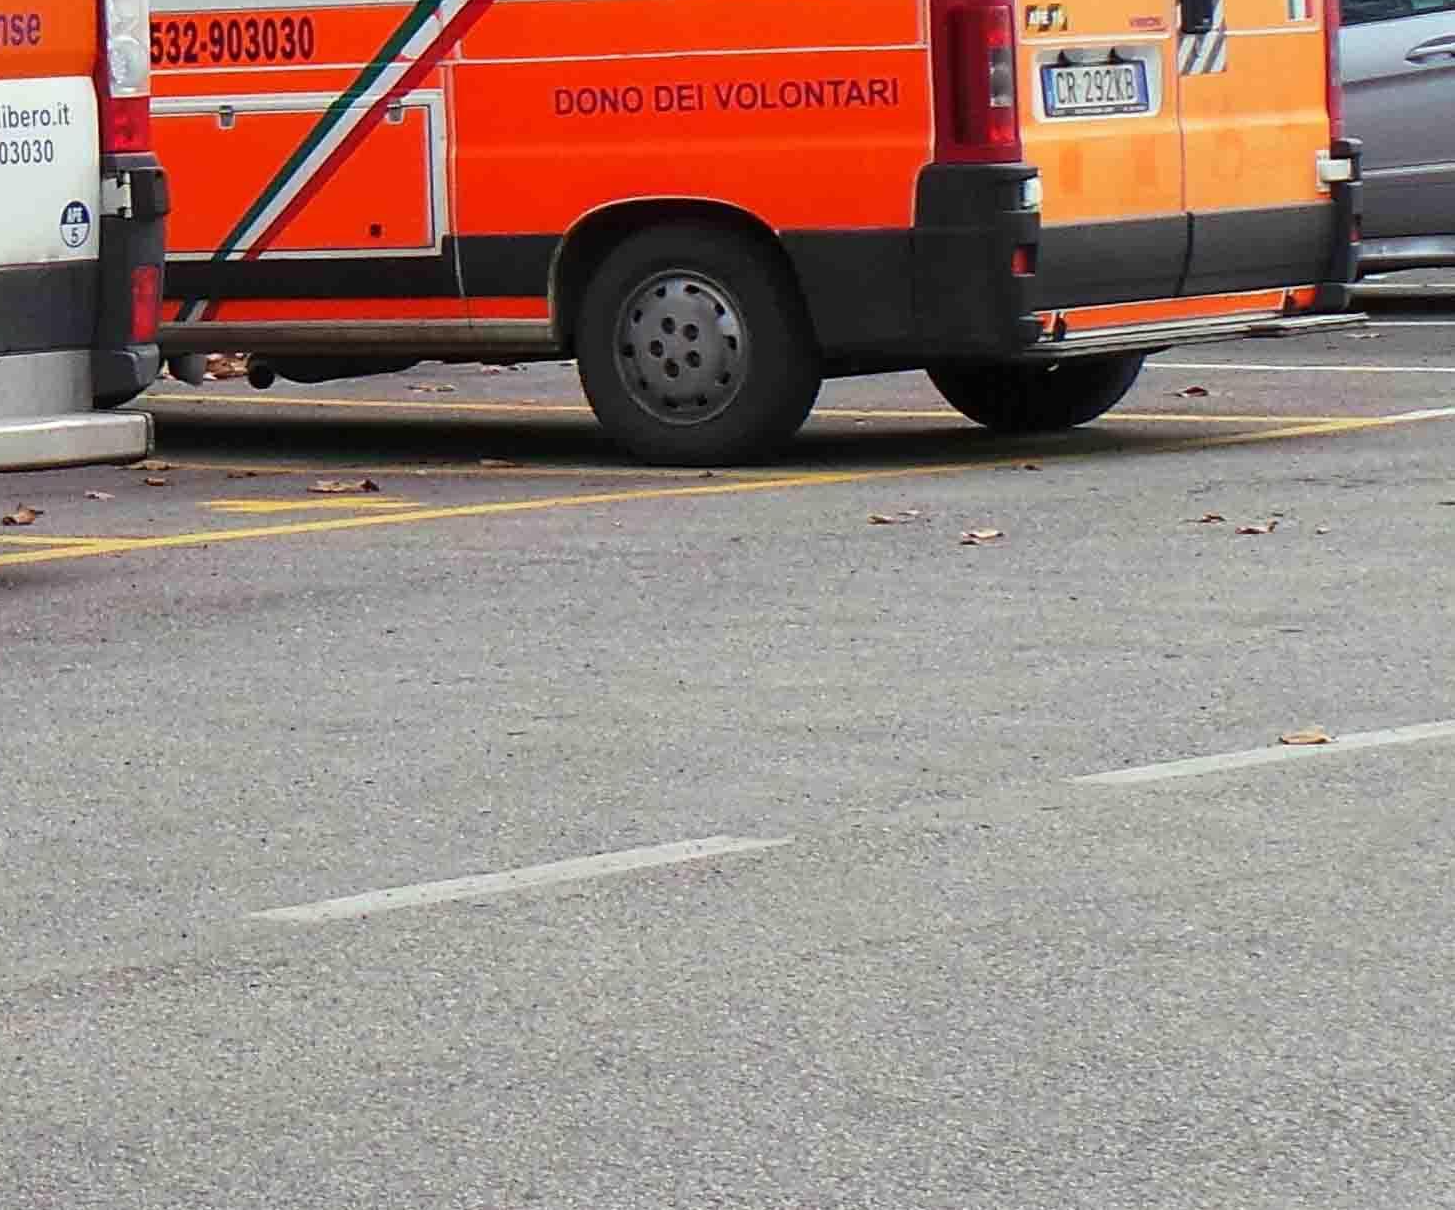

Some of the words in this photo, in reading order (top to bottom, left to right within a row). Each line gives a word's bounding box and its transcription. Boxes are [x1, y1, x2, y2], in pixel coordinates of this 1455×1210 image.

[554, 87, 643, 116] DONO
[653, 84, 705, 112] DEI
[714, 77, 899, 111] VOLONTARI
[1055, 71, 1078, 105] CR
[1084, 68, 1135, 103] 292KB
